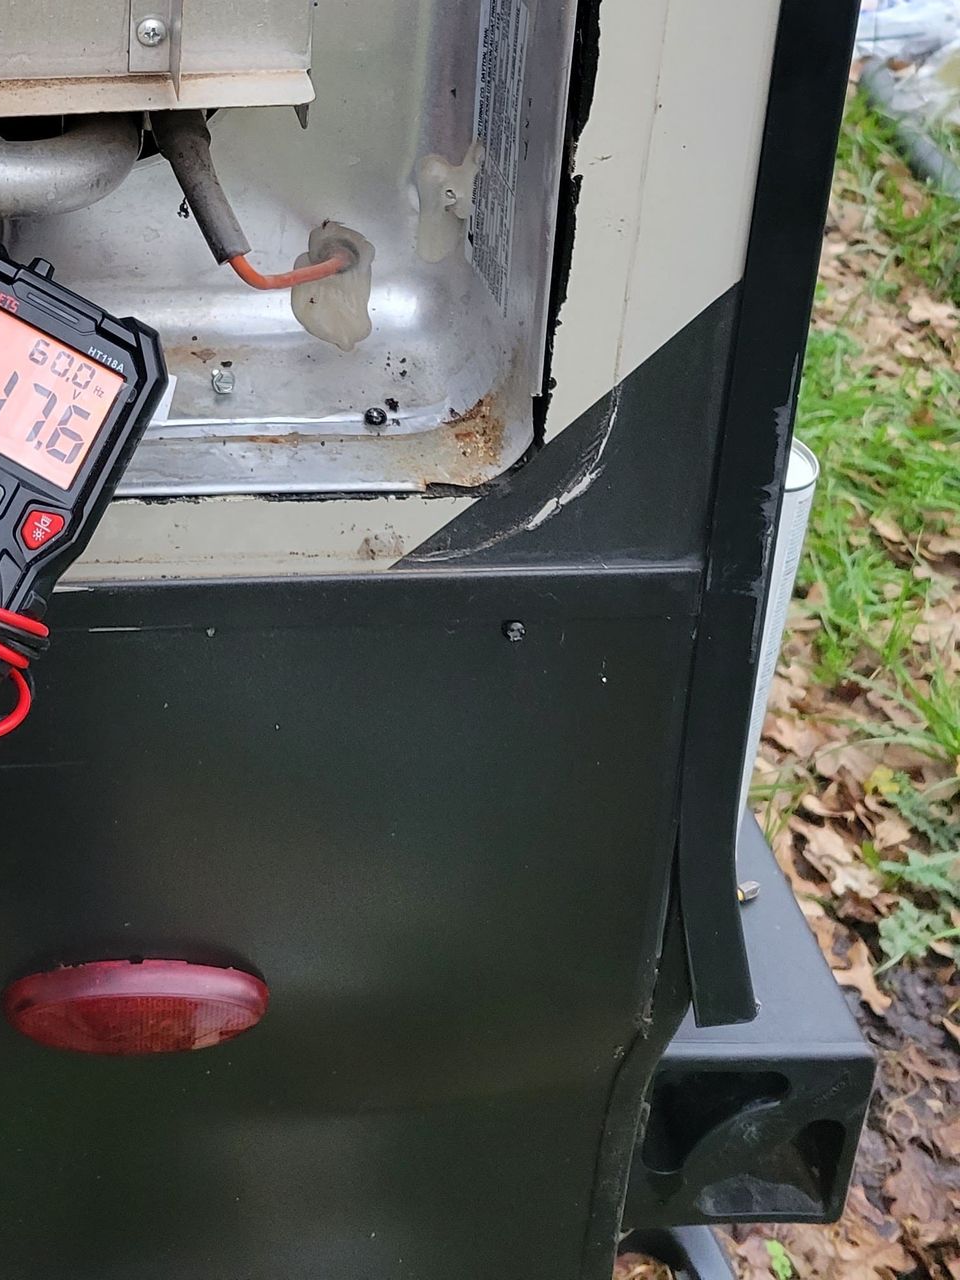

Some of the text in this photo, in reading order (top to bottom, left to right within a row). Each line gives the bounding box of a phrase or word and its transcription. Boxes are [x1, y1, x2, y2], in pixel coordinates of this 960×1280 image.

[28, 338, 105, 398] 60.0 Hz
[87, 345, 126, 373] HT118A
[72, 390, 82, 401] V
